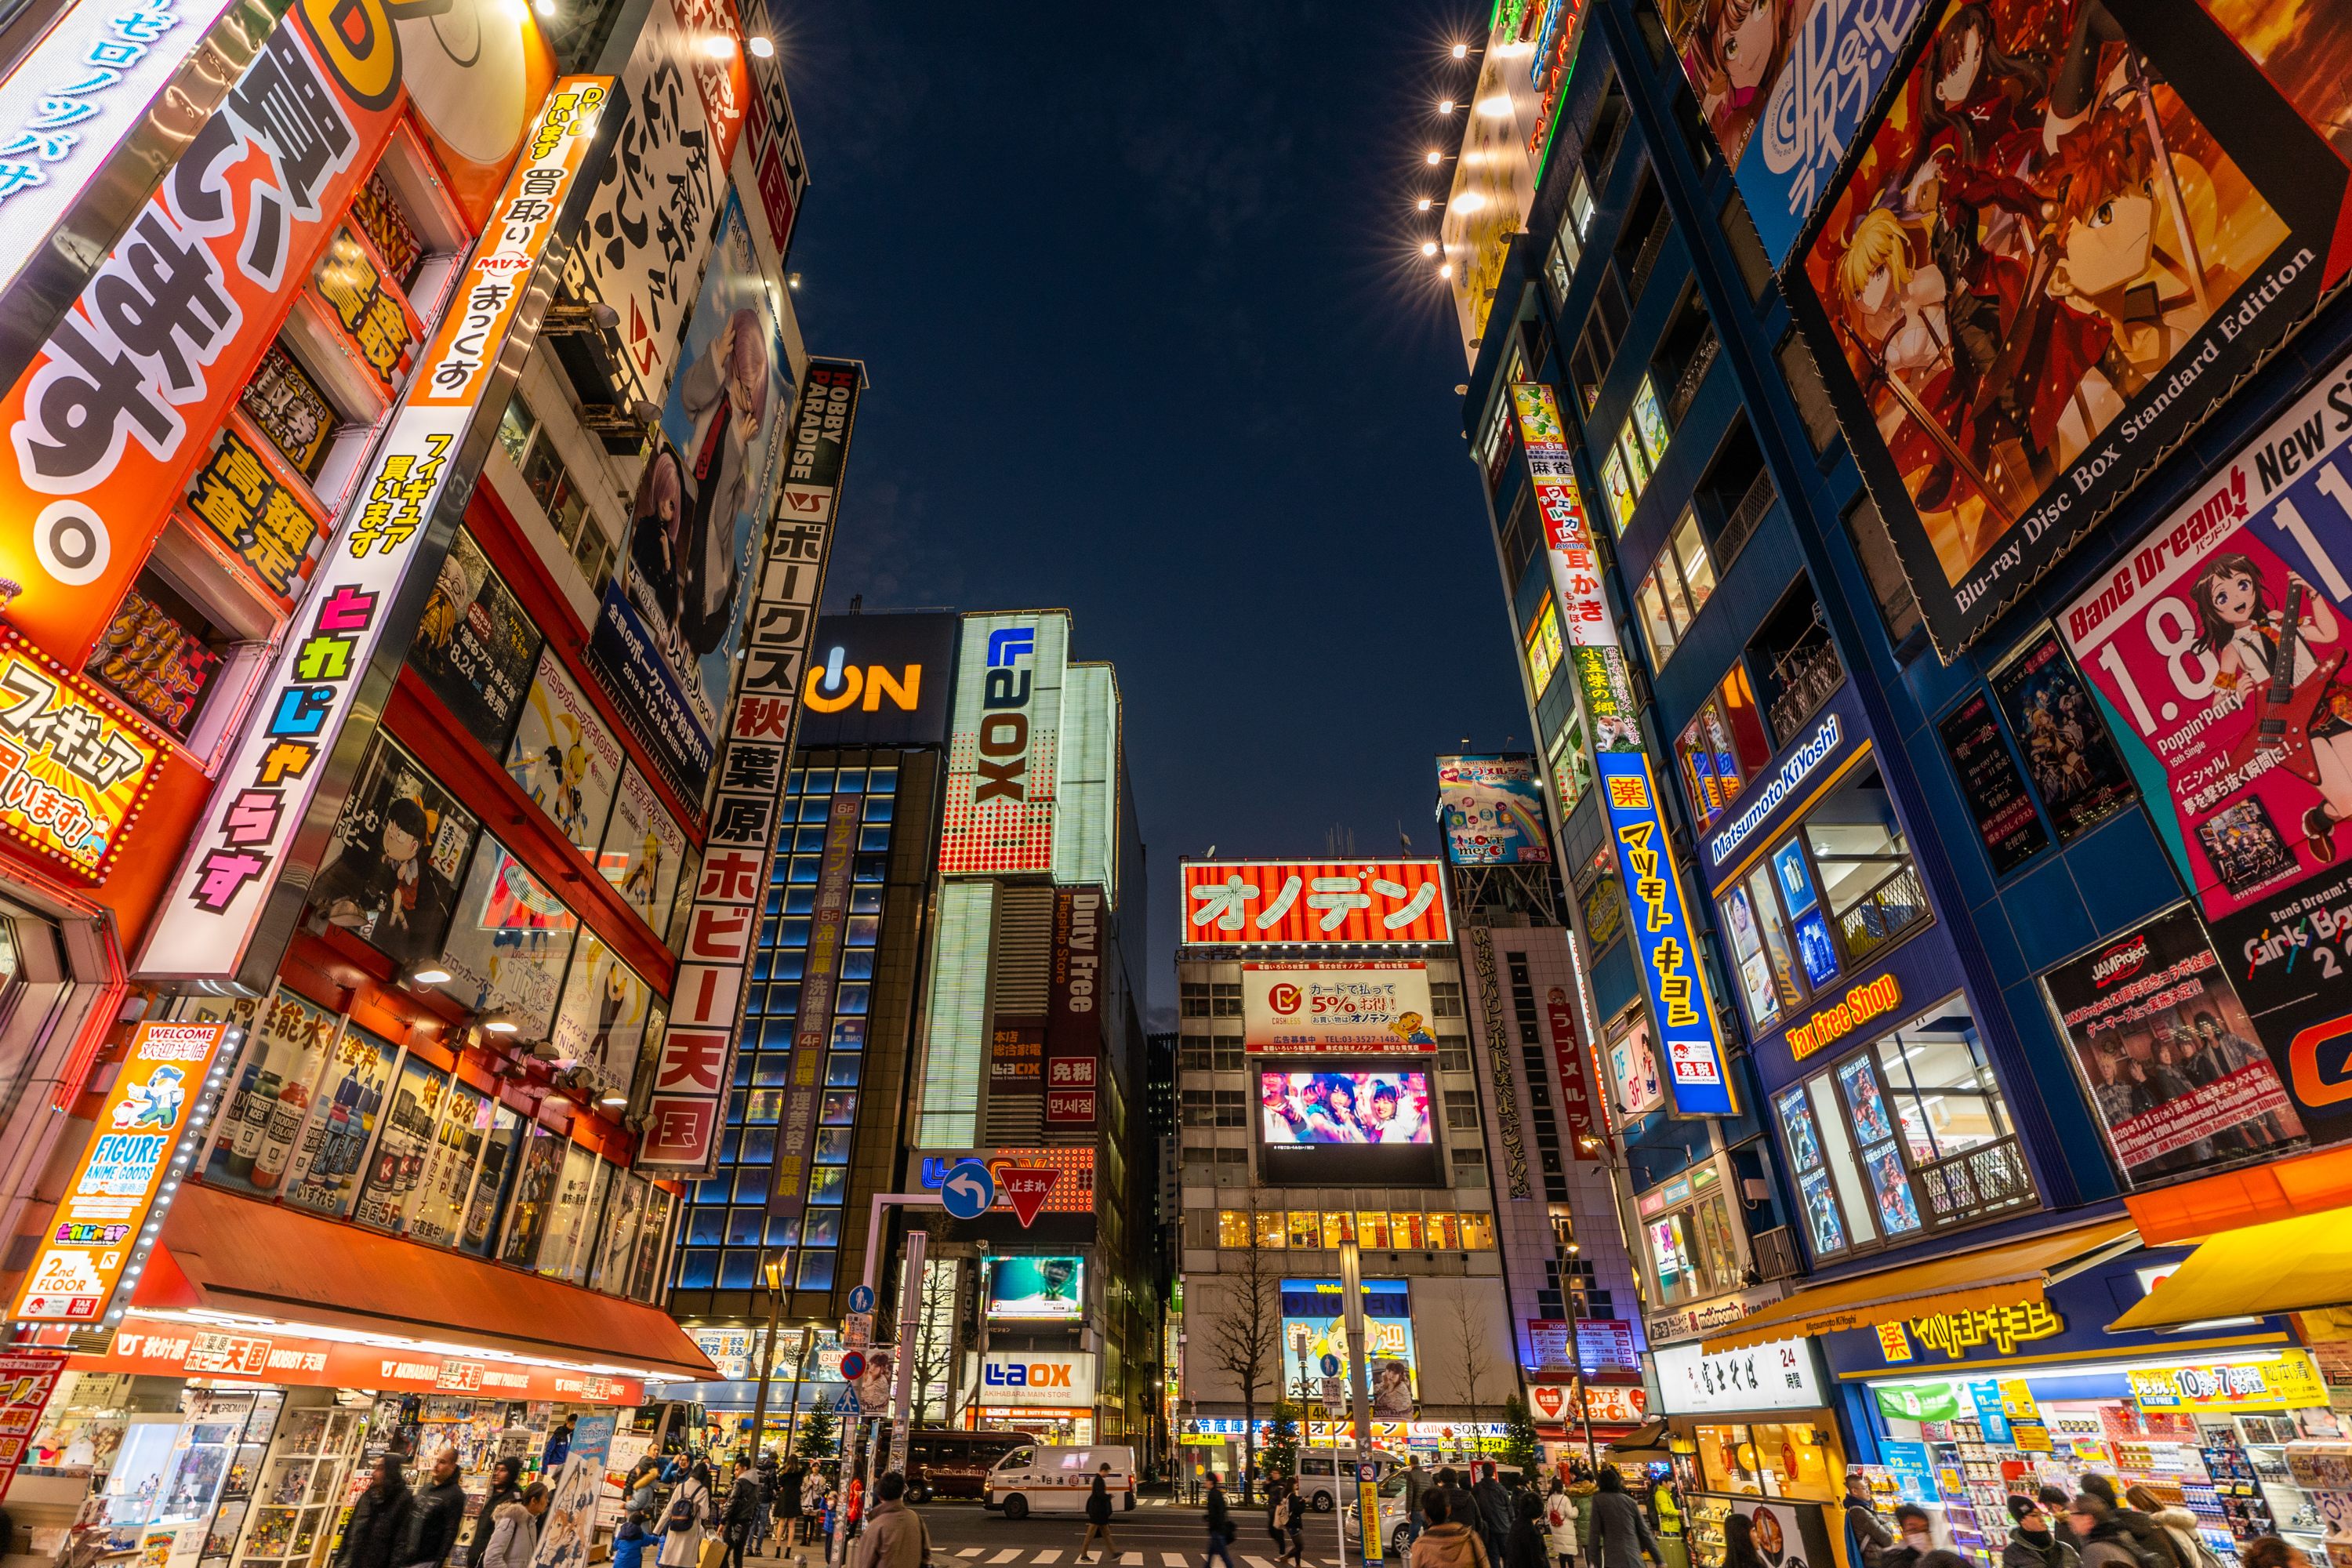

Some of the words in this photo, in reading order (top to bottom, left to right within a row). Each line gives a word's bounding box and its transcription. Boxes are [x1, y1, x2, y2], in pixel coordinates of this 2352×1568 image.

[533, 94, 581, 158] 買います
[568, 88, 604, 136] DVD
[506, 169, 564, 242] 買取り
[436, 285, 510, 390] まっくす
[822, 372, 853, 444] HOBBY
[789, 371, 830, 479] PARADISE
[1954, 541, 2023, 615] Blu-ray
[2021, 492, 2072, 545] Disc
[2070, 443, 2122, 495] Box
[2121, 344, 2220, 444] Standard
[2219, 246, 2317, 343] Edition
[1533, 461, 1573, 476] 麻雀
[349, 456, 416, 558] 買います
[381, 434, 453, 554] フィギュア
[2069, 567, 2135, 644] BanG
[2254, 410, 2326, 497] New
[2196, 517, 2232, 555] バンドリ
[1563, 550, 1602, 622] 耳かき
[1564, 591, 1585, 646] もみほぐし
[2099, 595, 2219, 738] 1.8
[449, 647, 474, 681] 8.24
[484, 684, 506, 720] 発売!
[1581, 648, 1617, 715] 小豆柴の郷
[2, 660, 143, 792] フィギュア
[2157, 691, 2244, 756] Poppin'Party
[193, 586, 376, 912] とれじゃらす
[2170, 754, 2186, 768] 15th
[2184, 741, 2206, 761] Single
[1612, 779, 1646, 806] 薬
[1713, 782, 1784, 863] Matsumoto
[1781, 718, 1838, 791] KiYoshi
[837, 803, 855, 814] 6F
[1468, 835, 1504, 846] LOVE
[1191, 866, 1436, 932] オノデン
[2270, 902, 2299, 924] BanG
[2301, 882, 2345, 909] Dream!
[819, 910, 839, 922] 5F
[1055, 894, 1070, 945] Flagship
[1069, 895, 1099, 950] Duty
[2244, 924, 2309, 967] Girls
[1056, 949, 1069, 984] Store
[1069, 956, 1098, 1012] Free
[1310, 984, 1396, 996] カードで払って
[2065, 1010, 2083, 1027] JAM
[2082, 997, 2111, 1020] Project
[2111, 950, 2217, 1006] 20周年記念コラボ企画
[1310, 996, 1356, 1014] 5%
[1359, 998, 1397, 1011] お得!
[1788, 1025, 1817, 1060] Tax
[1813, 1003, 1852, 1037] Free
[1848, 975, 1898, 1025] Shop
[2087, 978, 2205, 1038] ゲーマーズにて実施決定!!
[149, 1027, 216, 1040] WELCOME
[800, 1035, 820, 1047] 4F
[994, 1031, 1018, 1043] 本店
[1273, 1036, 1316, 1044] 広告募集中
[139, 1043, 209, 1059] 欢迎光临
[993, 1044, 1041, 1056] 総合家電
[1052, 1062, 1091, 1081] 免税
[1615, 1051, 1625, 1080] 2F
[1680, 1062, 1710, 1076] 免税
[1629, 1076, 1642, 1107] 3F
[1051, 1098, 1092, 1114] 면세점
[274, 1111, 298, 1130] MODEL
[2154, 1122, 2171, 1139] 20th
[2171, 1109, 2218, 1132] Anniversary
[93, 1135, 167, 1163] FIGURE
[85, 1165, 118, 1180] ANIME
[119, 1166, 153, 1180] GOODS
[1011, 1179, 1047, 1192] 止まれ
[296, 1181, 336, 1208] いずれも
[45, 1258, 75, 1277] 2nd
[38, 1279, 86, 1292] FLOOR
[72, 1306, 89, 1315] FREE
[1806, 1320, 1835, 1332] Matsumoto
[1835, 1315, 1857, 1327] KiYoshi
[142, 1336, 191, 1359] 秋叶原
[1381, 1323, 1406, 1351] 迎
[267, 1349, 303, 1370] HOBBY
[394, 1362, 439, 1381] AKIHABARA
[1780, 1348, 1796, 1367] 24
[2263, 1361, 2311, 1382] 松本清
[483, 1370, 503, 1386] HOBBY
[501, 1373, 529, 1388] PARADISE
[1702, 1354, 1759, 1396] 富士そば
[1785, 1373, 1802, 1389] 時間
[2134, 1372, 2176, 1396] 免税!
[1310, 1421, 1397, 1434] オノン
